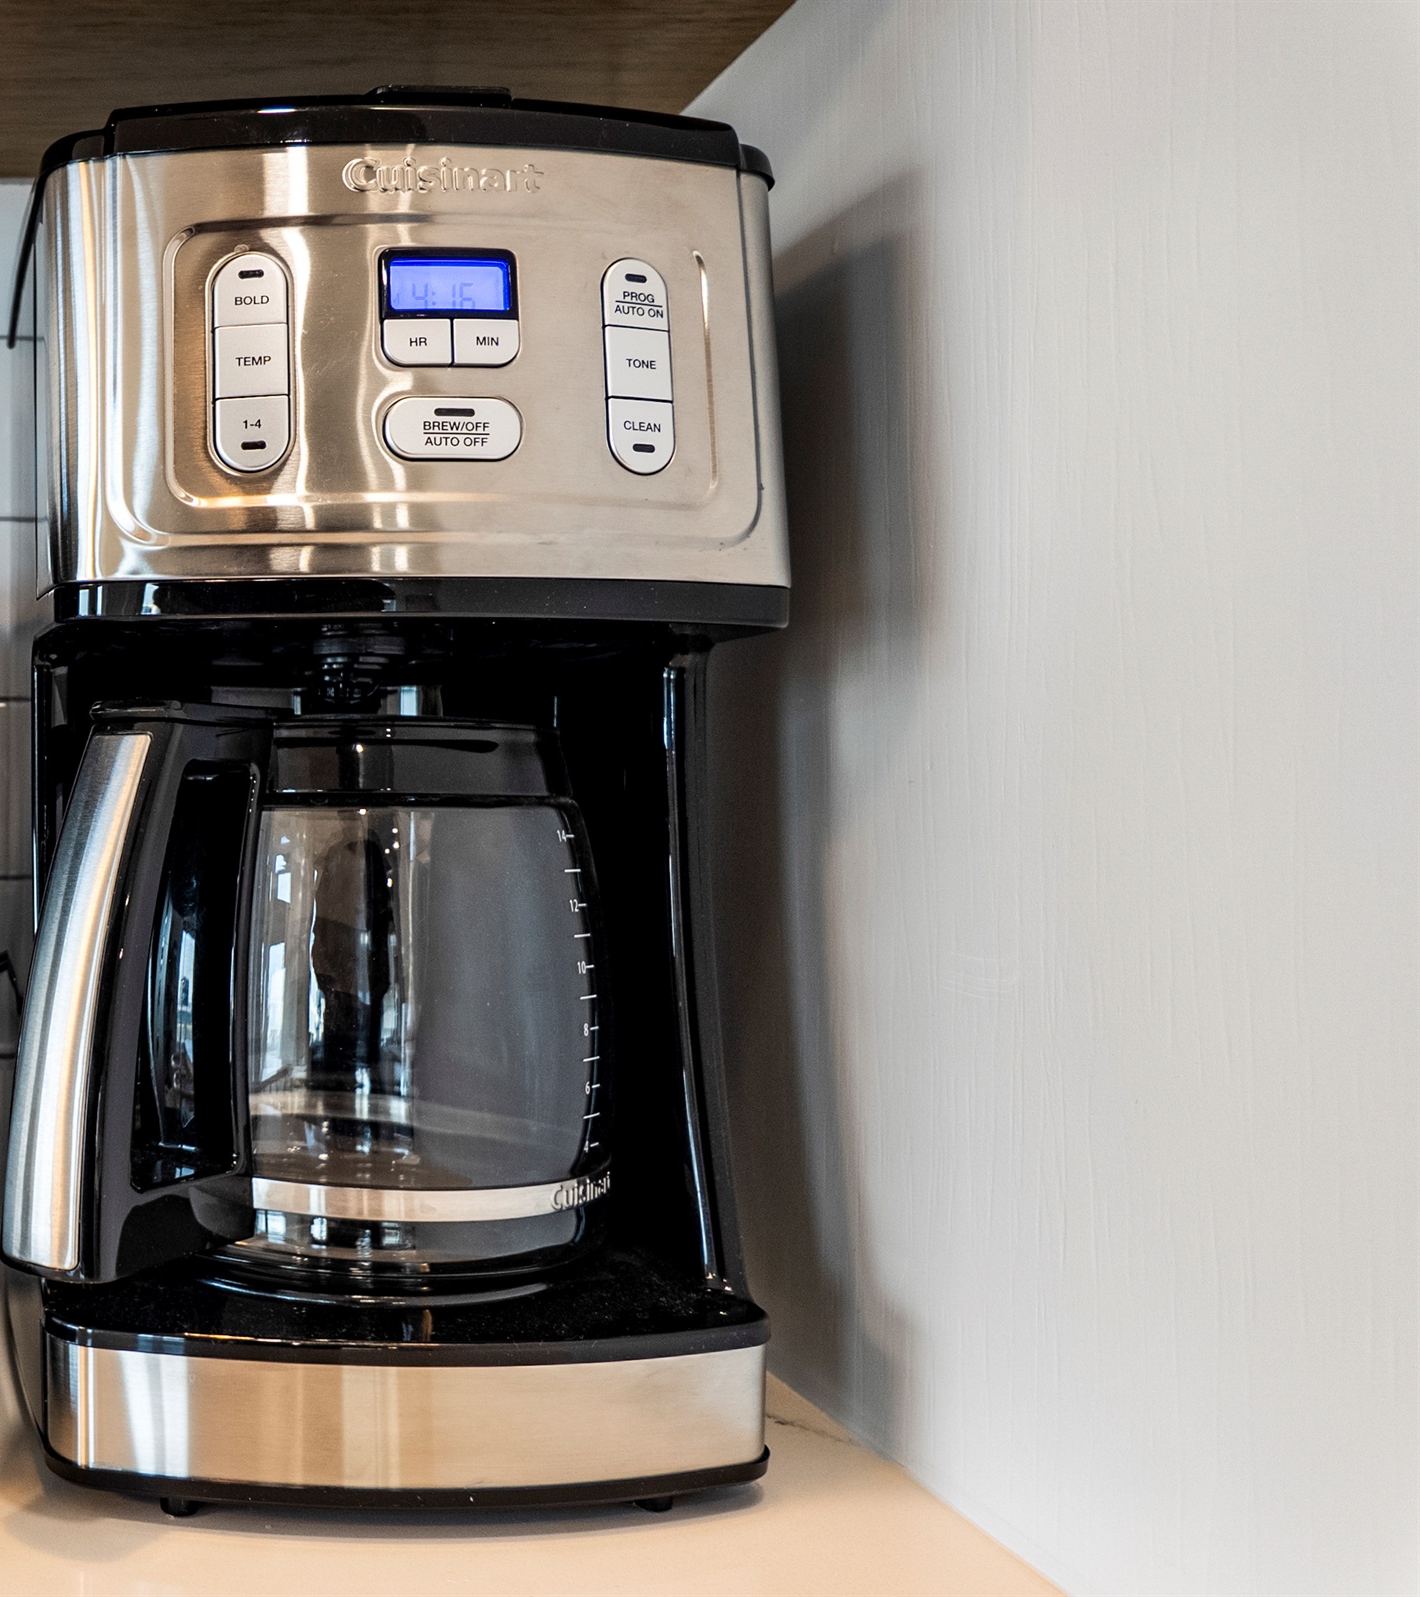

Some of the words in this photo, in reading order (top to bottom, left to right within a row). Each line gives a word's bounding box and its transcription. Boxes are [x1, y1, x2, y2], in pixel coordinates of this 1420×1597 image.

[342, 157, 544, 194] Cuisinart
[234, 294, 270, 307] BOLD
[411, 282, 476, 309] 4:16
[622, 291, 656, 304] PROG
[614, 305, 647, 318] AUTO
[648, 308, 665, 320] ON
[409, 336, 428, 347] HR
[476, 336, 500, 347] MIN
[235, 355, 272, 368] TEMP
[625, 358, 657, 370] TONE
[242, 418, 262, 430] 1-4
[423, 421, 490, 433] BREW/OFF
[623, 420, 662, 434] CLEAN
[425, 436, 458, 448] AUTO
[461, 436, 489, 447] OFF
[556, 829, 567, 843] 14
[569, 899, 579, 912] 12
[577, 961, 587, 974] 10
[583, 1023, 589, 1036] 8
[585, 1082, 590, 1095] 6
[550, 1171, 611, 1211] Cuisinar
